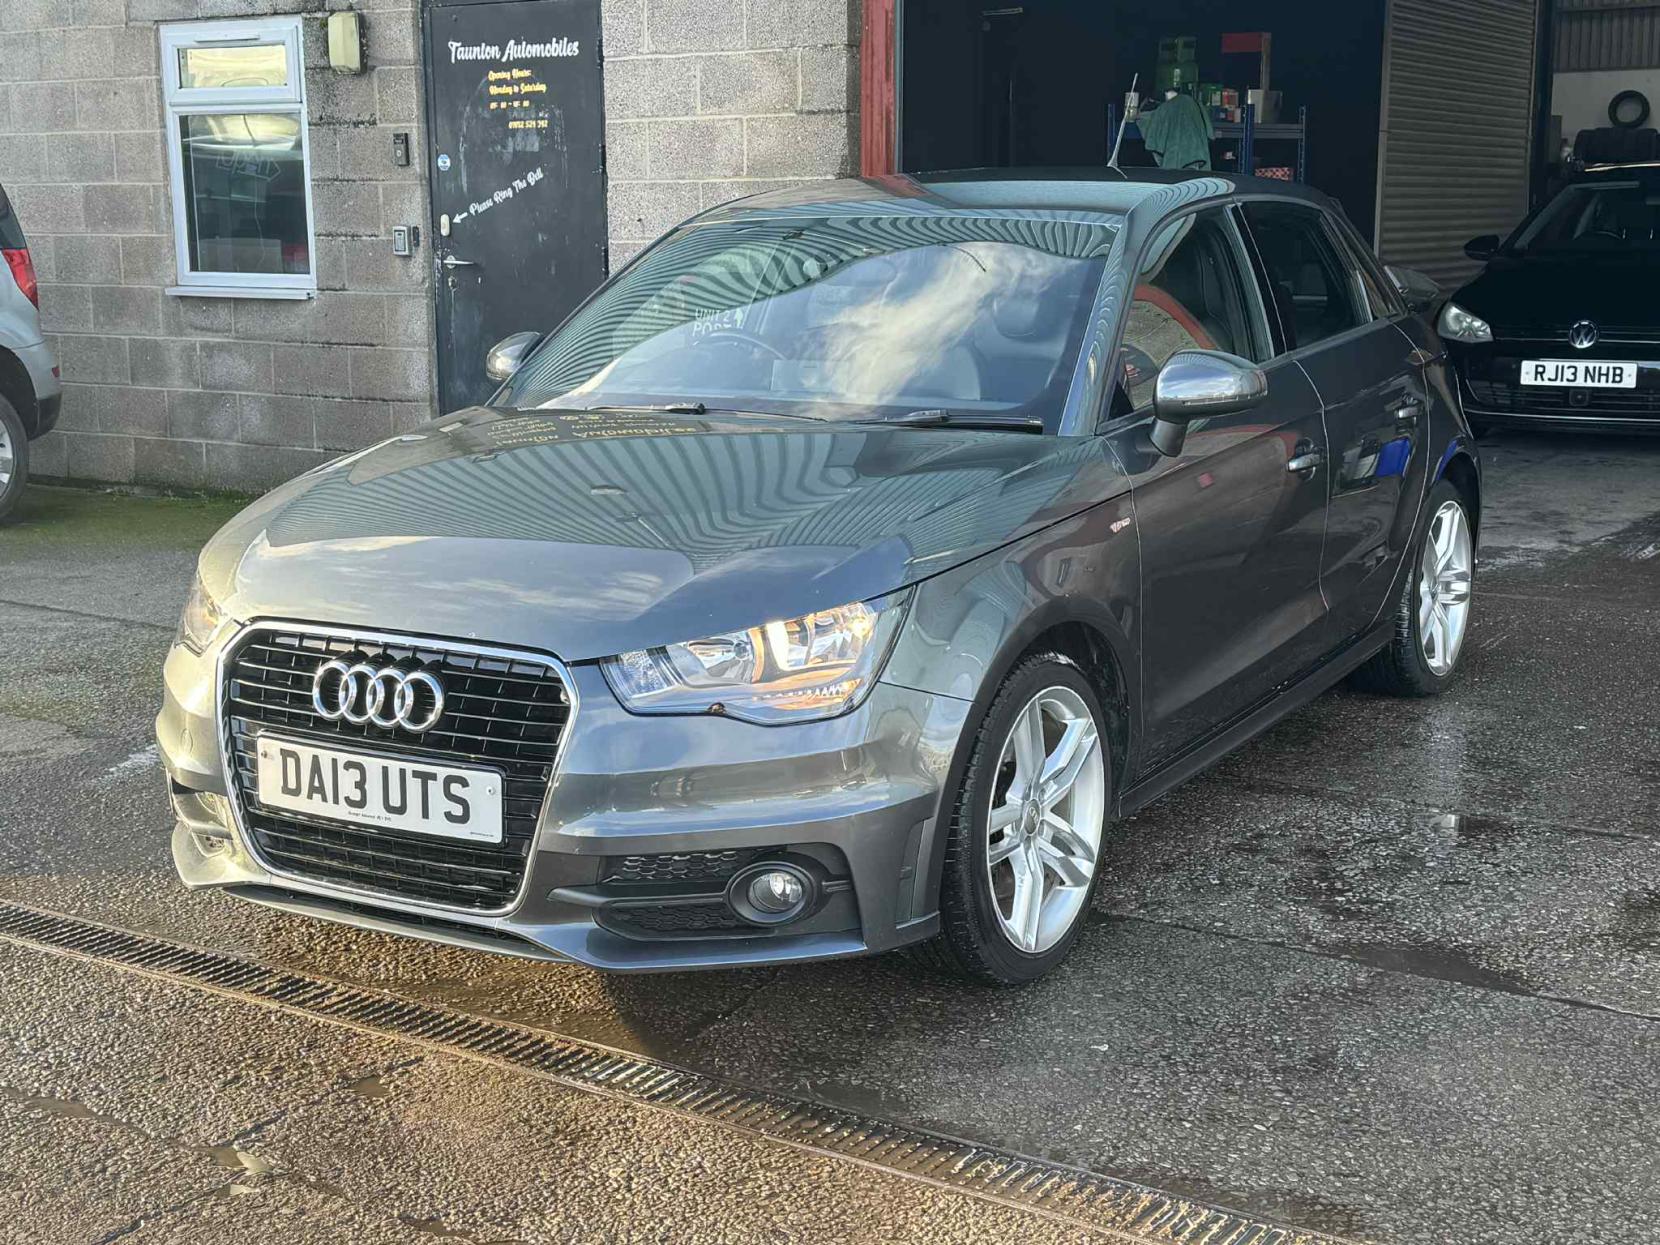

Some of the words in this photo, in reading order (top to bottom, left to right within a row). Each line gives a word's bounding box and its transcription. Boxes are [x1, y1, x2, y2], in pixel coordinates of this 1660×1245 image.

[448, 41, 501, 63] Taunton
[502, 37, 579, 62] Automobiles
[489, 85, 513, 95] Monday
[520, 82, 547, 94] Saturday
[469, 198, 493, 216] Please
[493, 187, 513, 204] Ring
[512, 179, 527, 193] The
[527, 167, 544, 186] Bell
[1534, 364, 1578, 382] RJ13
[1584, 366, 1624, 384] NHB
[279, 748, 368, 809] DA13
[382, 765, 471, 825] UTS
